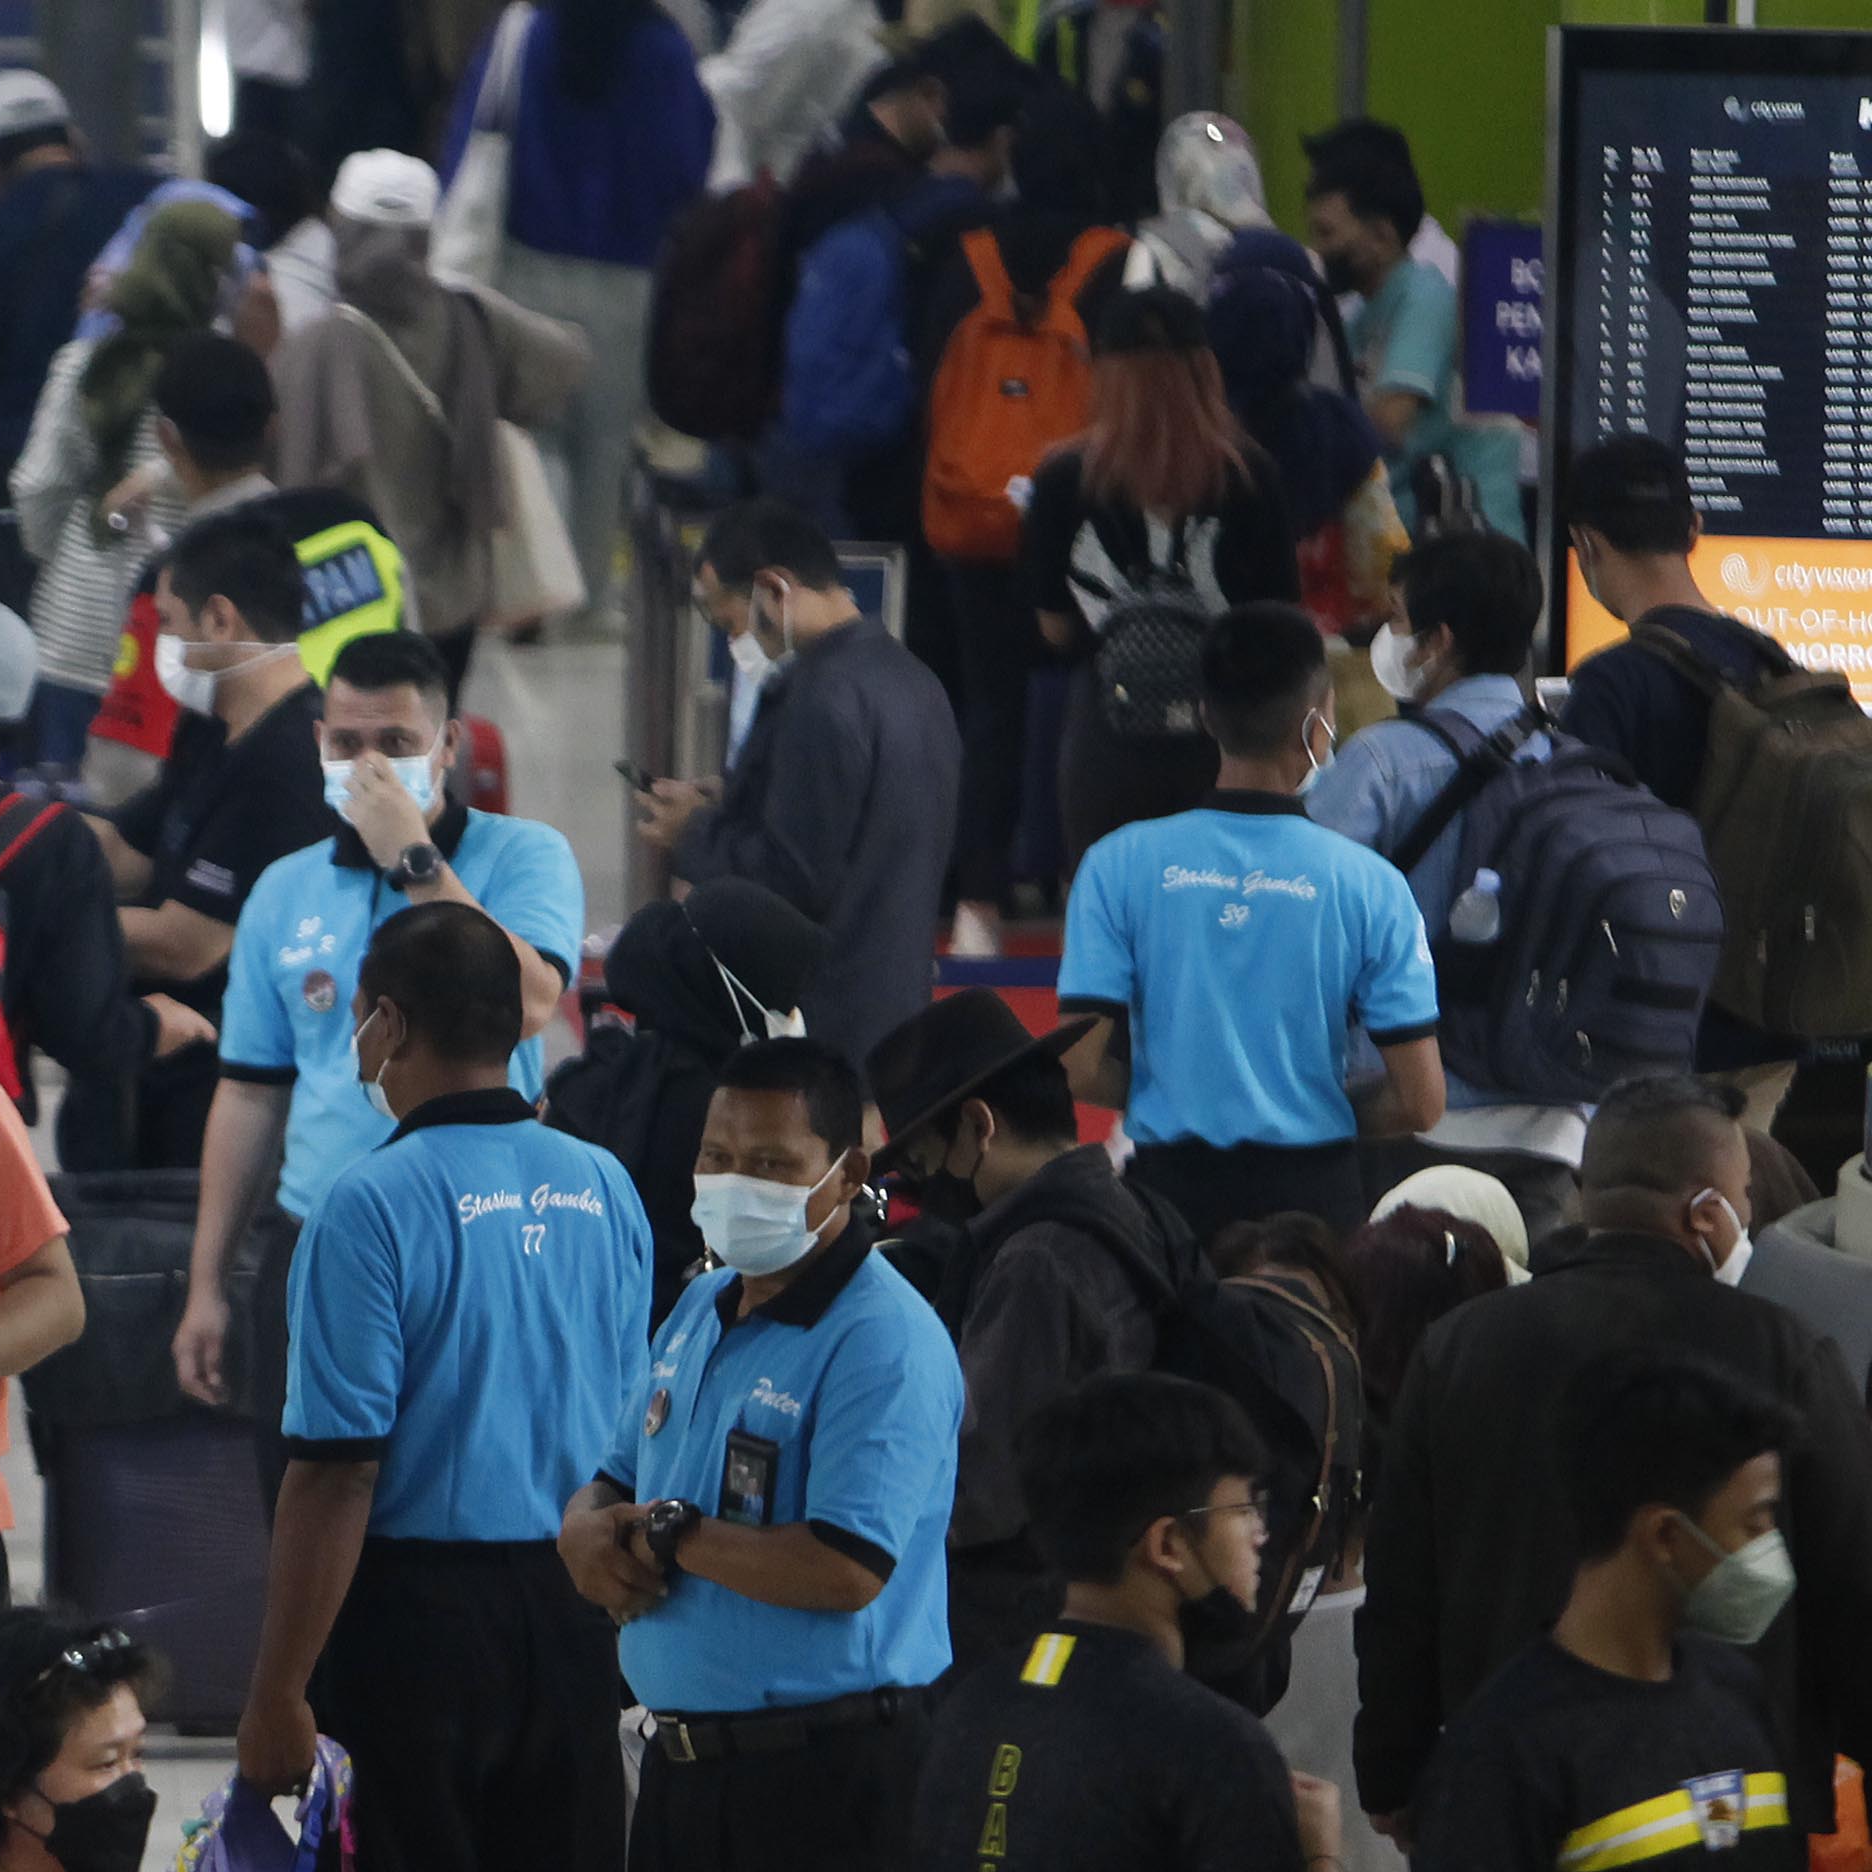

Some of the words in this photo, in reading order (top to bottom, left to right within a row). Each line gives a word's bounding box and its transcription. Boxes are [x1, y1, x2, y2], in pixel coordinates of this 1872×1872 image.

[1735, 606, 1872, 638] OUT-OF-H
[1786, 642, 1872, 671] MORR
[458, 1193, 522, 1224] Stasiun
[530, 1183, 604, 1217] Gambir
[521, 1223, 547, 1256] 77
